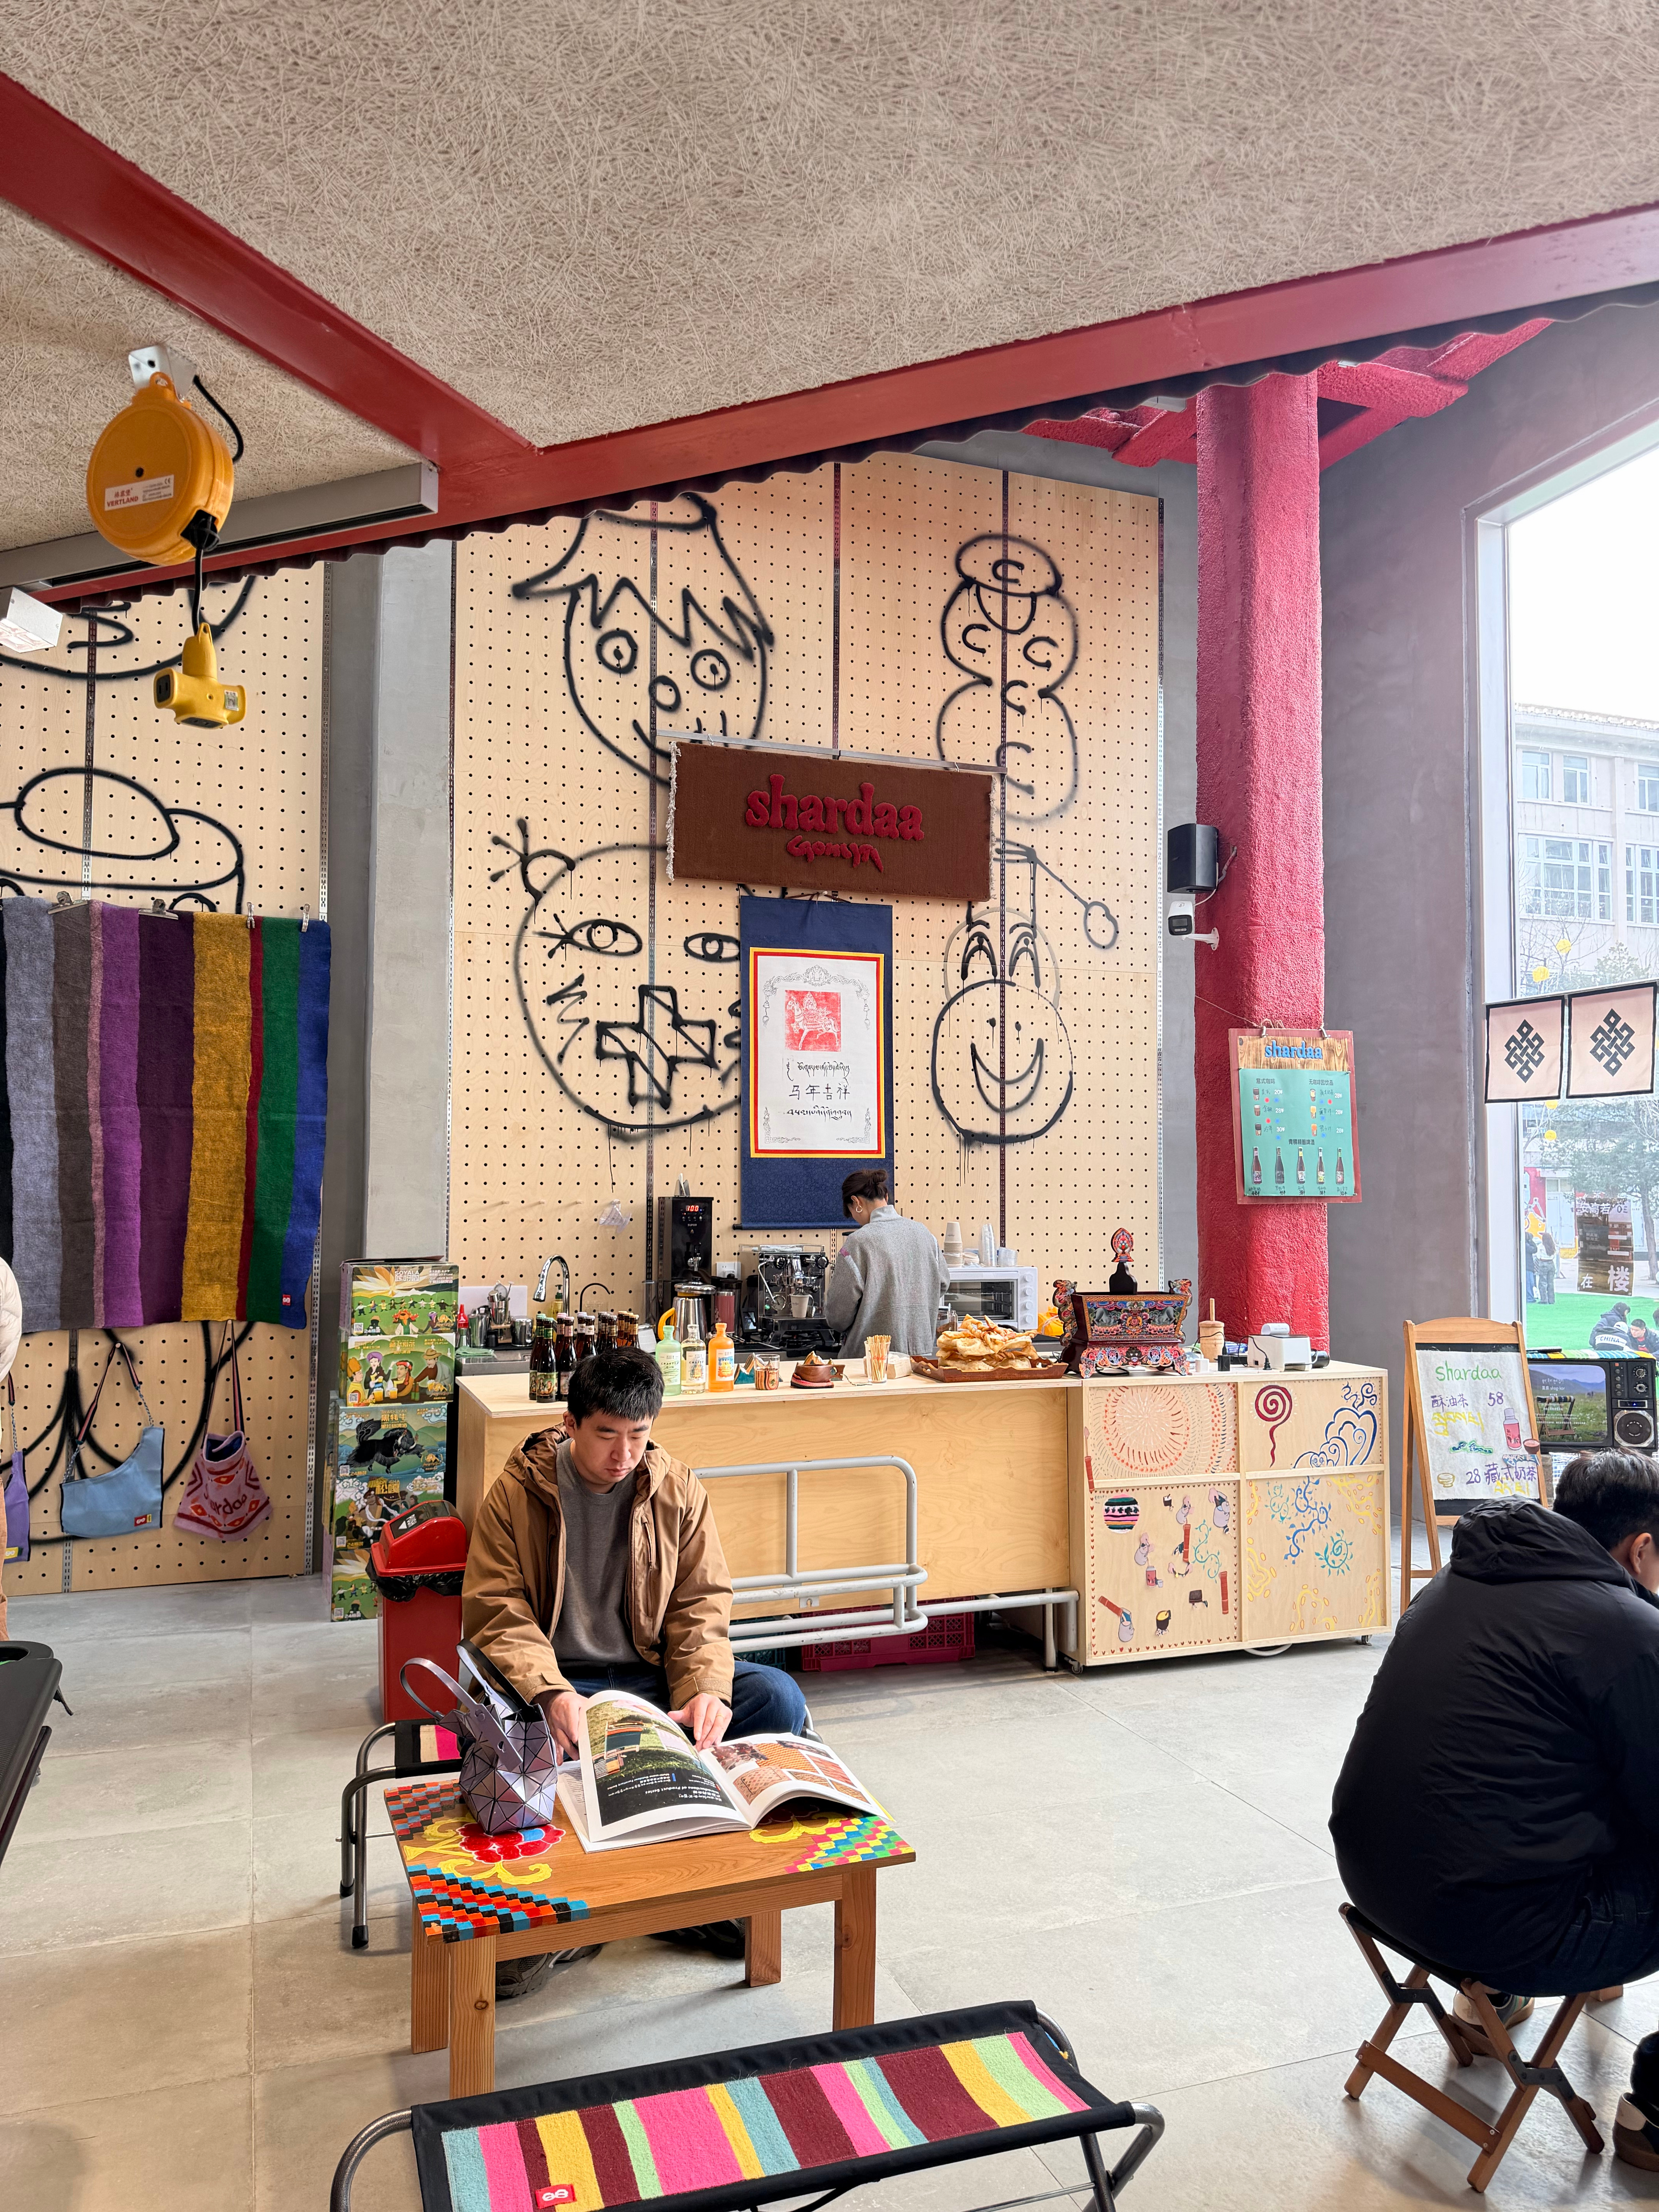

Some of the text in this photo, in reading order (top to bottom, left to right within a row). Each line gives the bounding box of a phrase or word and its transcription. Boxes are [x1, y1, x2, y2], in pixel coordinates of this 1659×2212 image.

[107, 496, 138, 507] VERTLAND
[745, 774, 924, 841] shardaa
[1265, 1039, 1323, 1059] shardaa
[789, 1083, 850, 1101] 马年吉祥
[1431, 1391, 1504, 1412] 酥油茶 58
[1466, 1468, 1481, 1485] 28
[1484, 1462, 1537, 1485] 藏式奶茶
